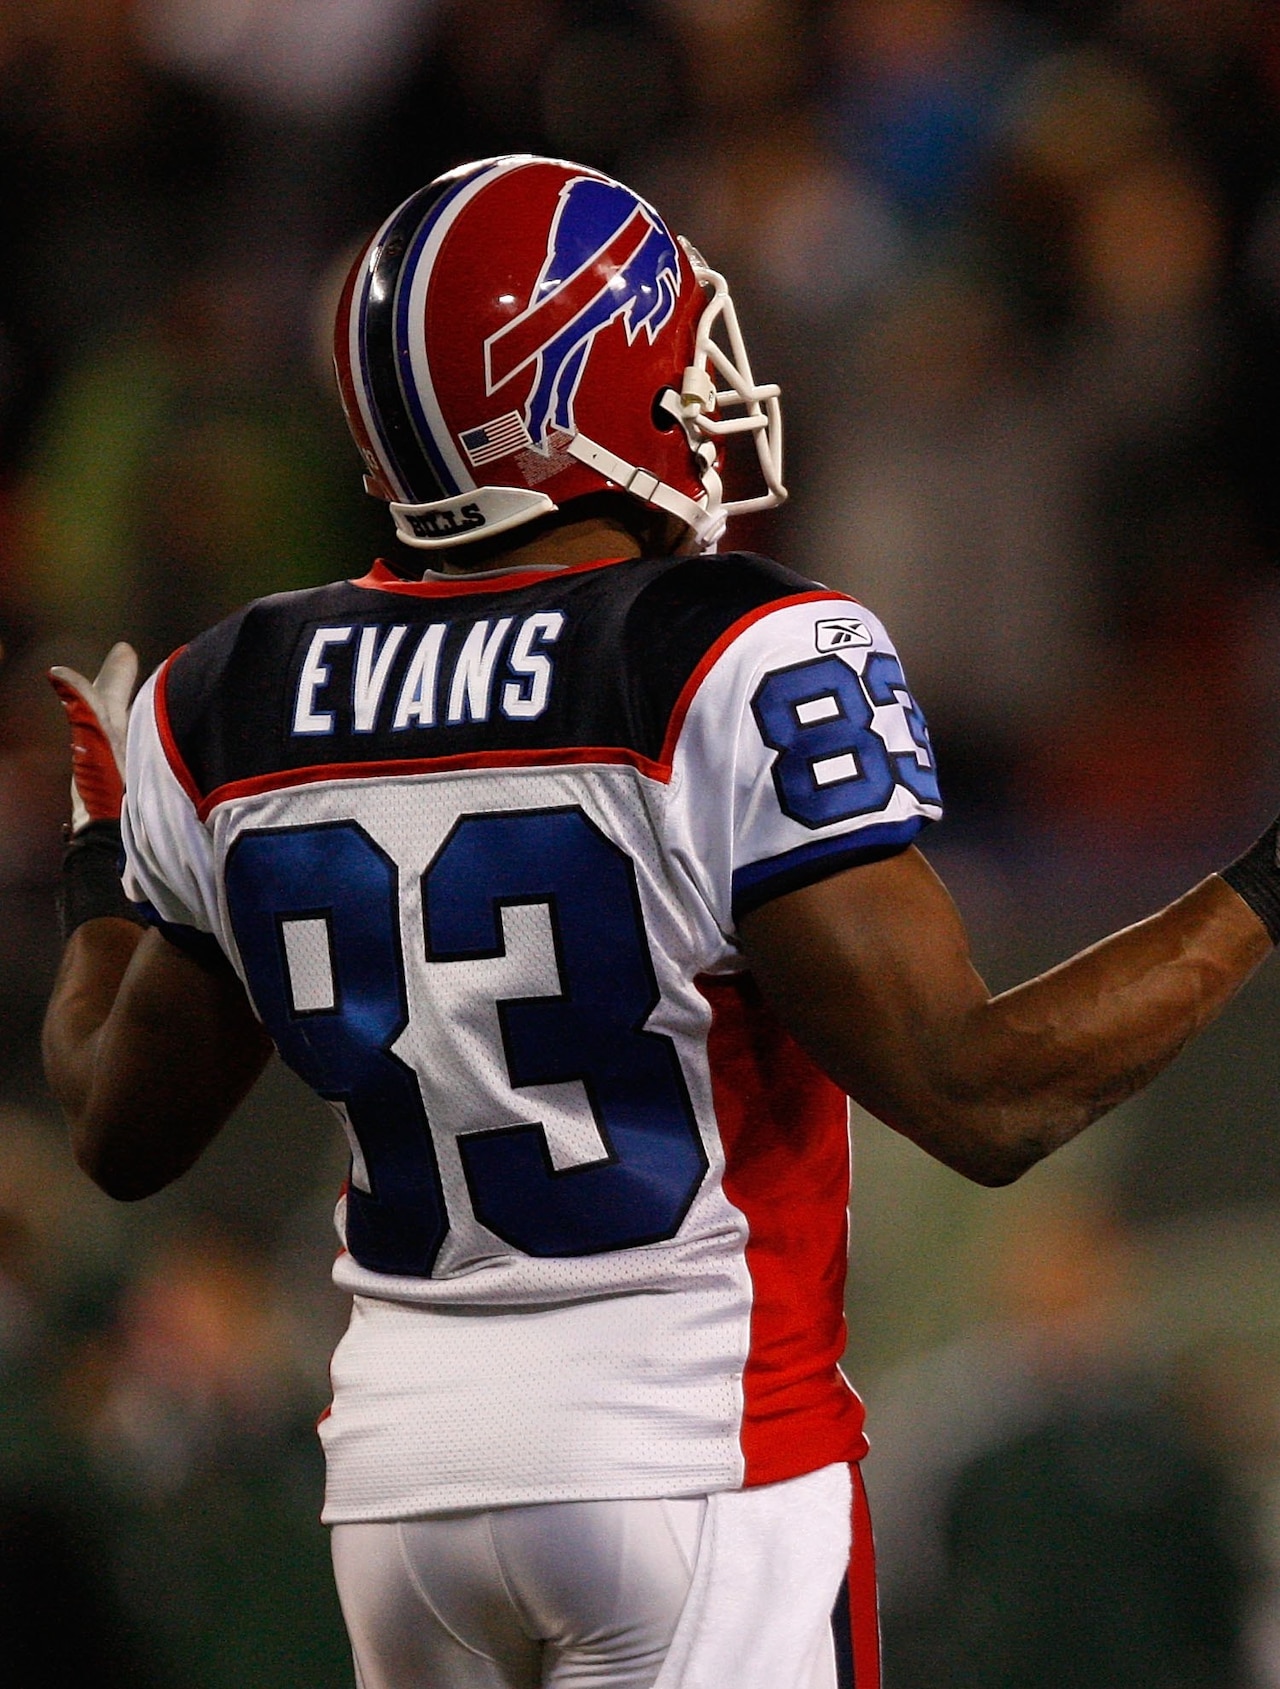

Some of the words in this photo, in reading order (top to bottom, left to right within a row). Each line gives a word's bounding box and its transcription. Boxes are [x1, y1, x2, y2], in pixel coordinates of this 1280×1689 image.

[404, 503, 486, 538] BILLS
[291, 609, 567, 736] EVANS
[750, 650, 943, 830] 83
[225, 804, 710, 1279] 83
